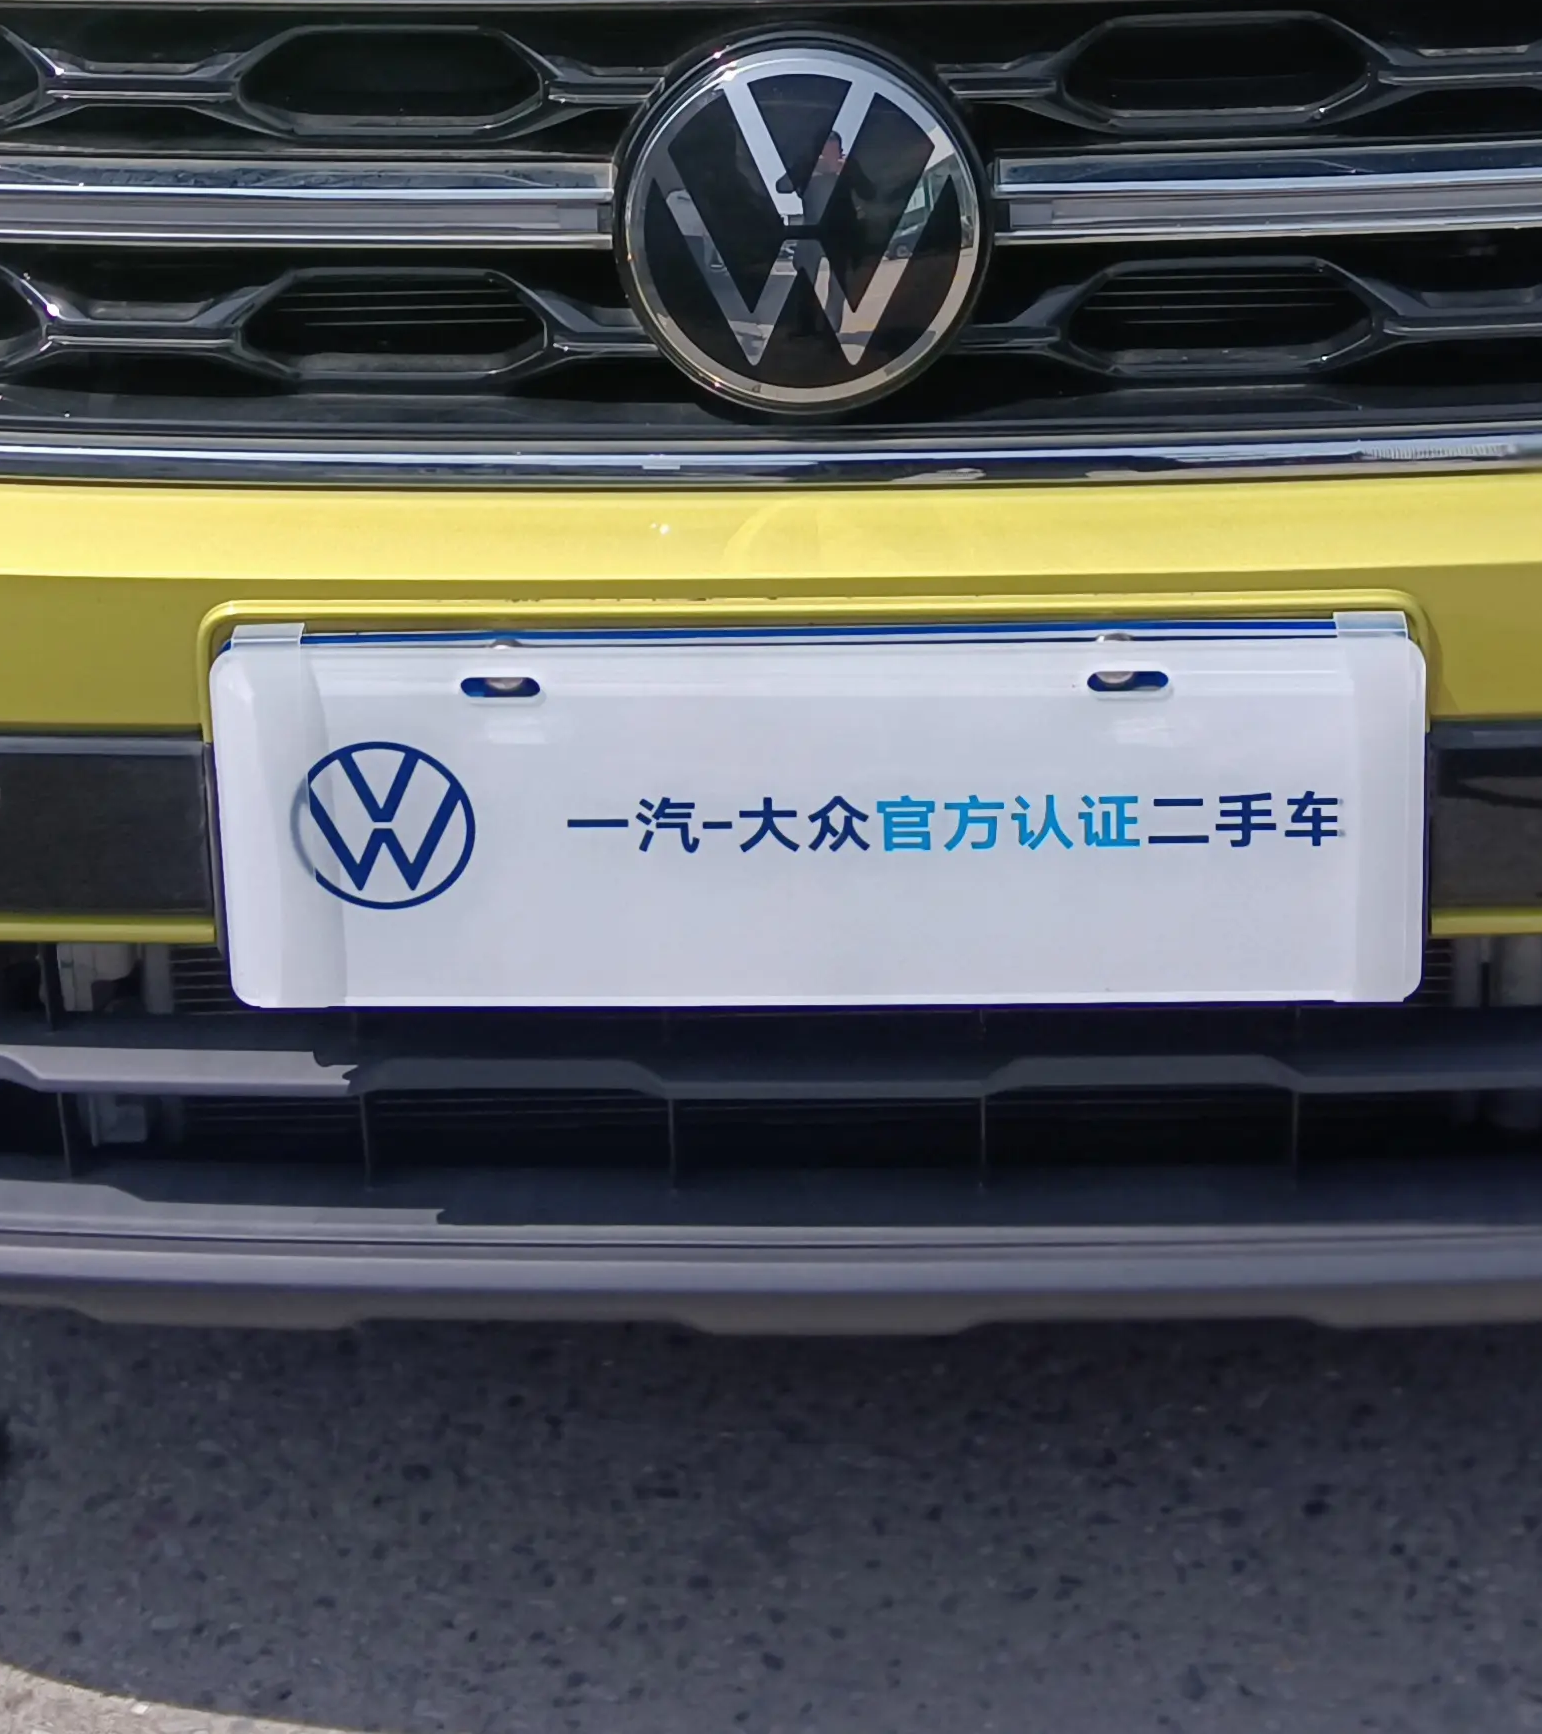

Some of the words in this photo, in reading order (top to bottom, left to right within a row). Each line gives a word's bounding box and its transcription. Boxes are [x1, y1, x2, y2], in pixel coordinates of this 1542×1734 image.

[566, 790, 1344, 854] 一汽-大众官方认证二手车
